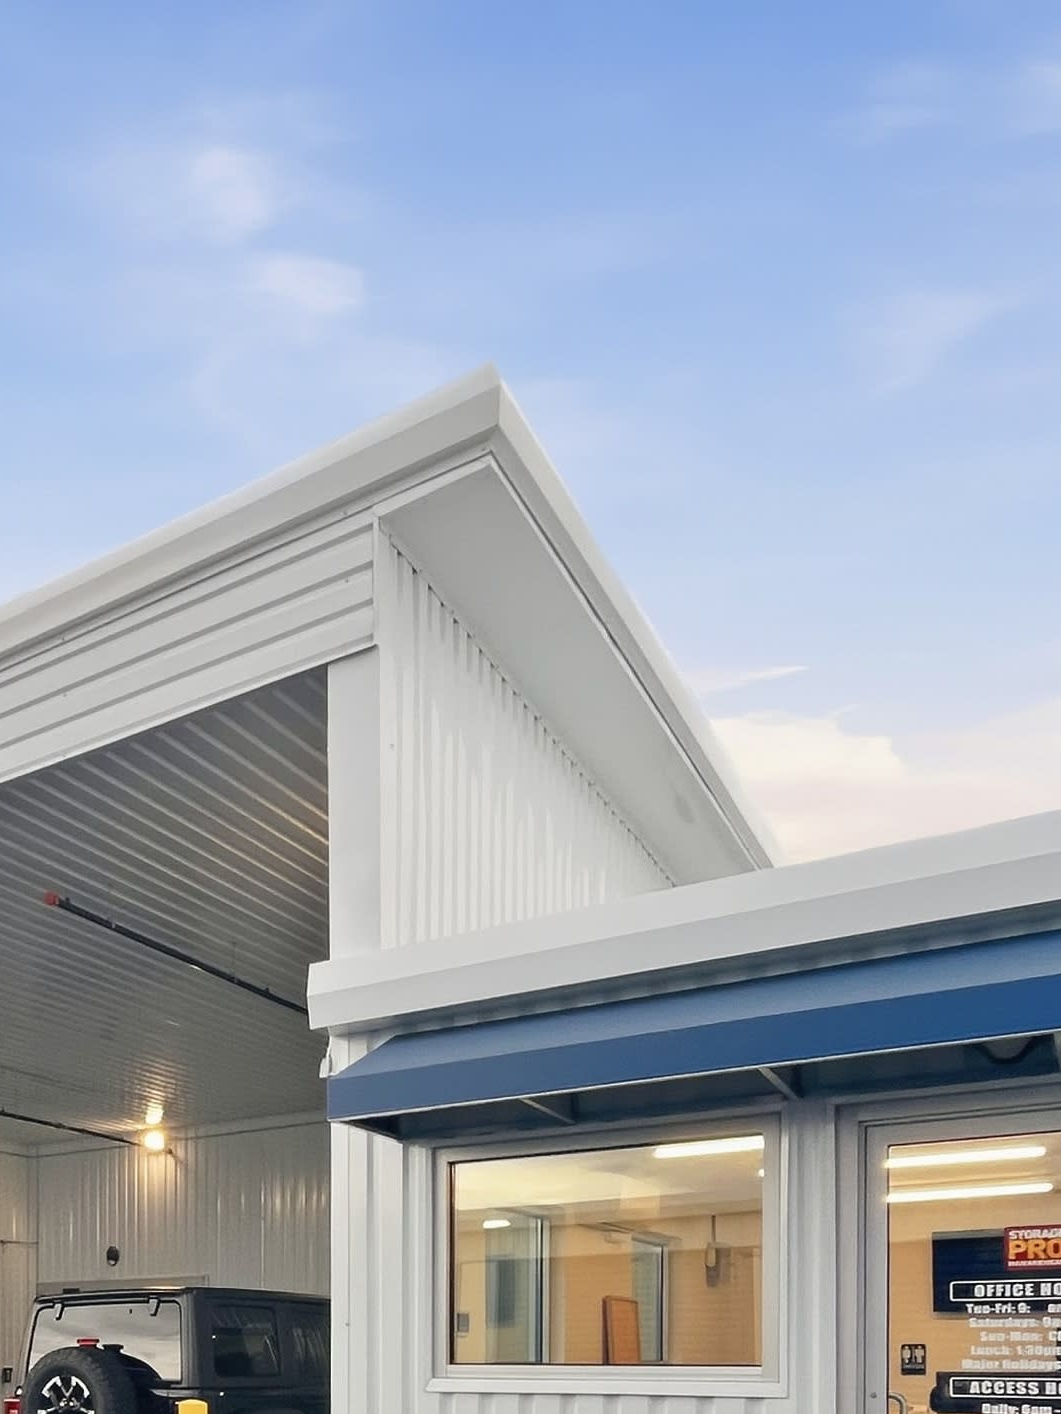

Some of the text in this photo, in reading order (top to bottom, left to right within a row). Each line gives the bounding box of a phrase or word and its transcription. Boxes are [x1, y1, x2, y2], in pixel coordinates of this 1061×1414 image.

[1008, 1238, 1061, 1260] PRO
[974, 1284, 1034, 1297] OFFICE
[969, 1381, 1061, 1396] ACCESS H
